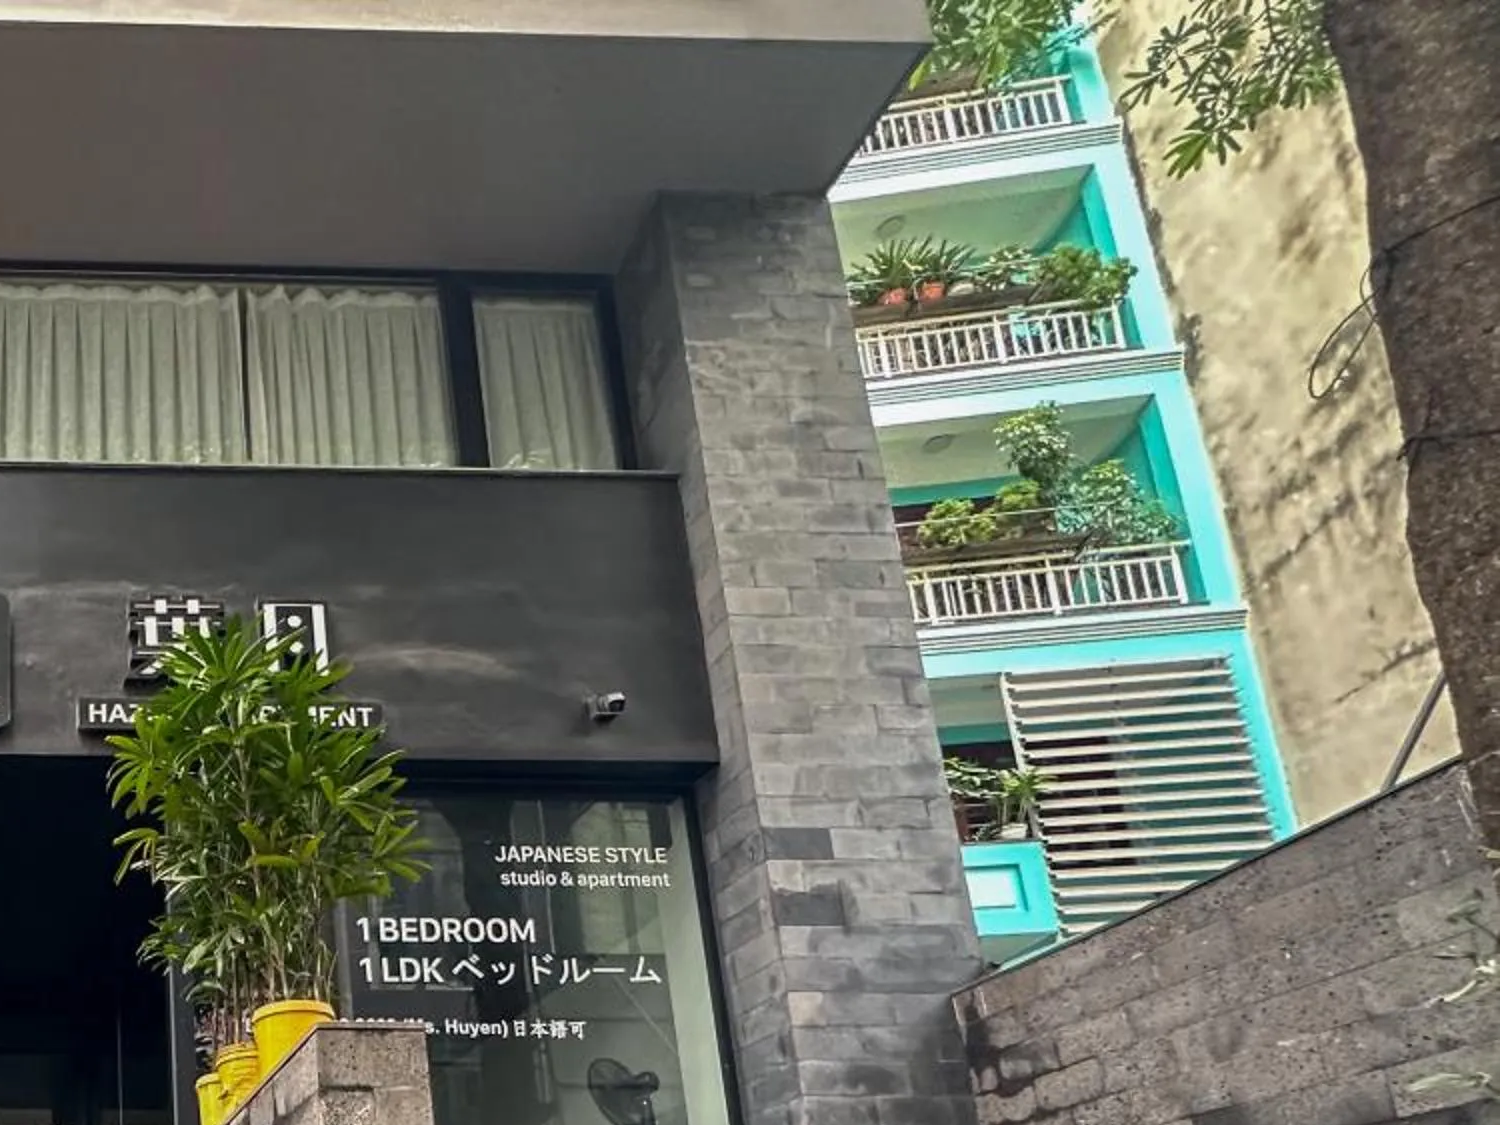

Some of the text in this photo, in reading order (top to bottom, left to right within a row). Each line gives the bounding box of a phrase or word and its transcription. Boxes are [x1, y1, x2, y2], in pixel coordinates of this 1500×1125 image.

[494, 845, 669, 864] JAPANESE STYLE
[500, 870, 671, 890] studio & apartment
[378, 917, 537, 944] BEDROOM
[451, 953, 662, 985] ベッドルーム
[445, 1019, 509, 1038] Huyen)
